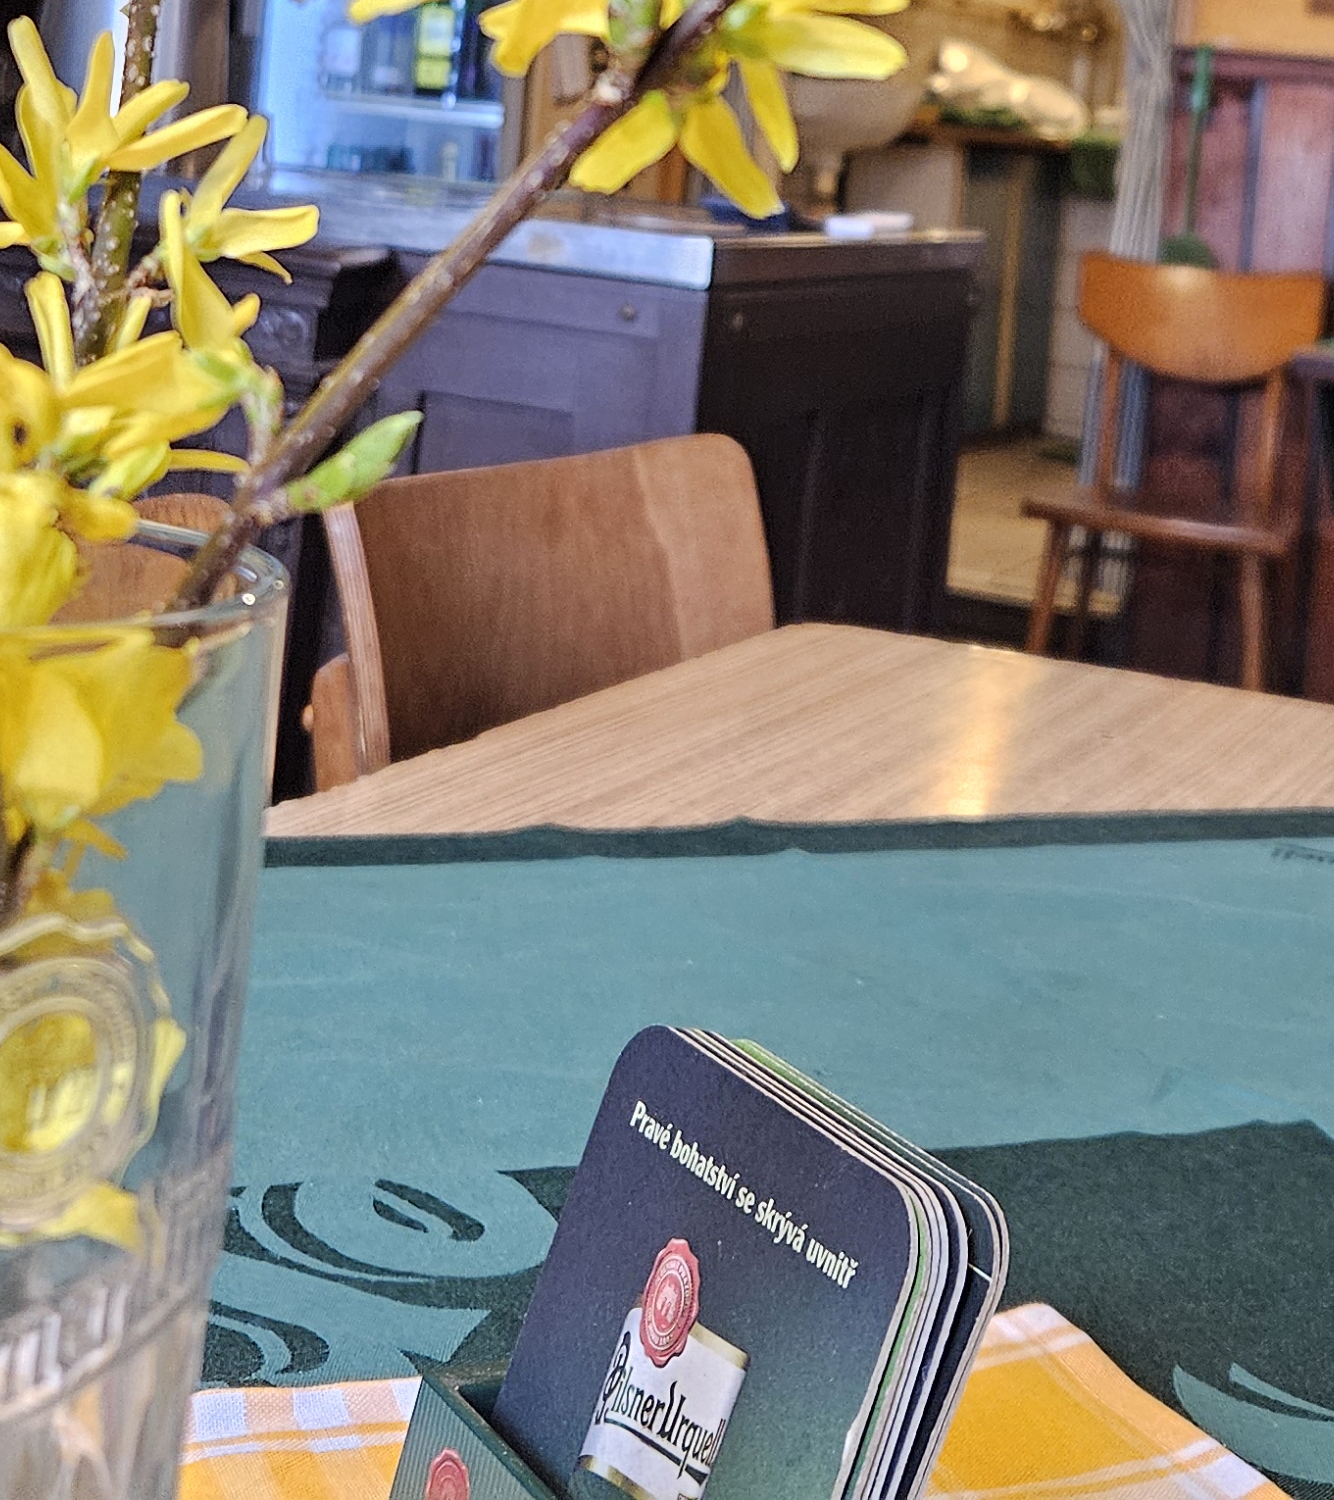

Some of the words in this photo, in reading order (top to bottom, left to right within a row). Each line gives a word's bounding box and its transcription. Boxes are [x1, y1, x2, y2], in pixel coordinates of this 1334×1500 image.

[629, 1100, 673, 1150] Pravé
[670, 1130, 740, 1199] bohatství
[735, 1186, 756, 1214] se
[755, 1198, 808, 1253] skrývá
[806, 1237, 859, 1289] uvnitř
[594, 1331, 665, 1432] Pilsner
[657, 1380, 726, 1479] Urquell
